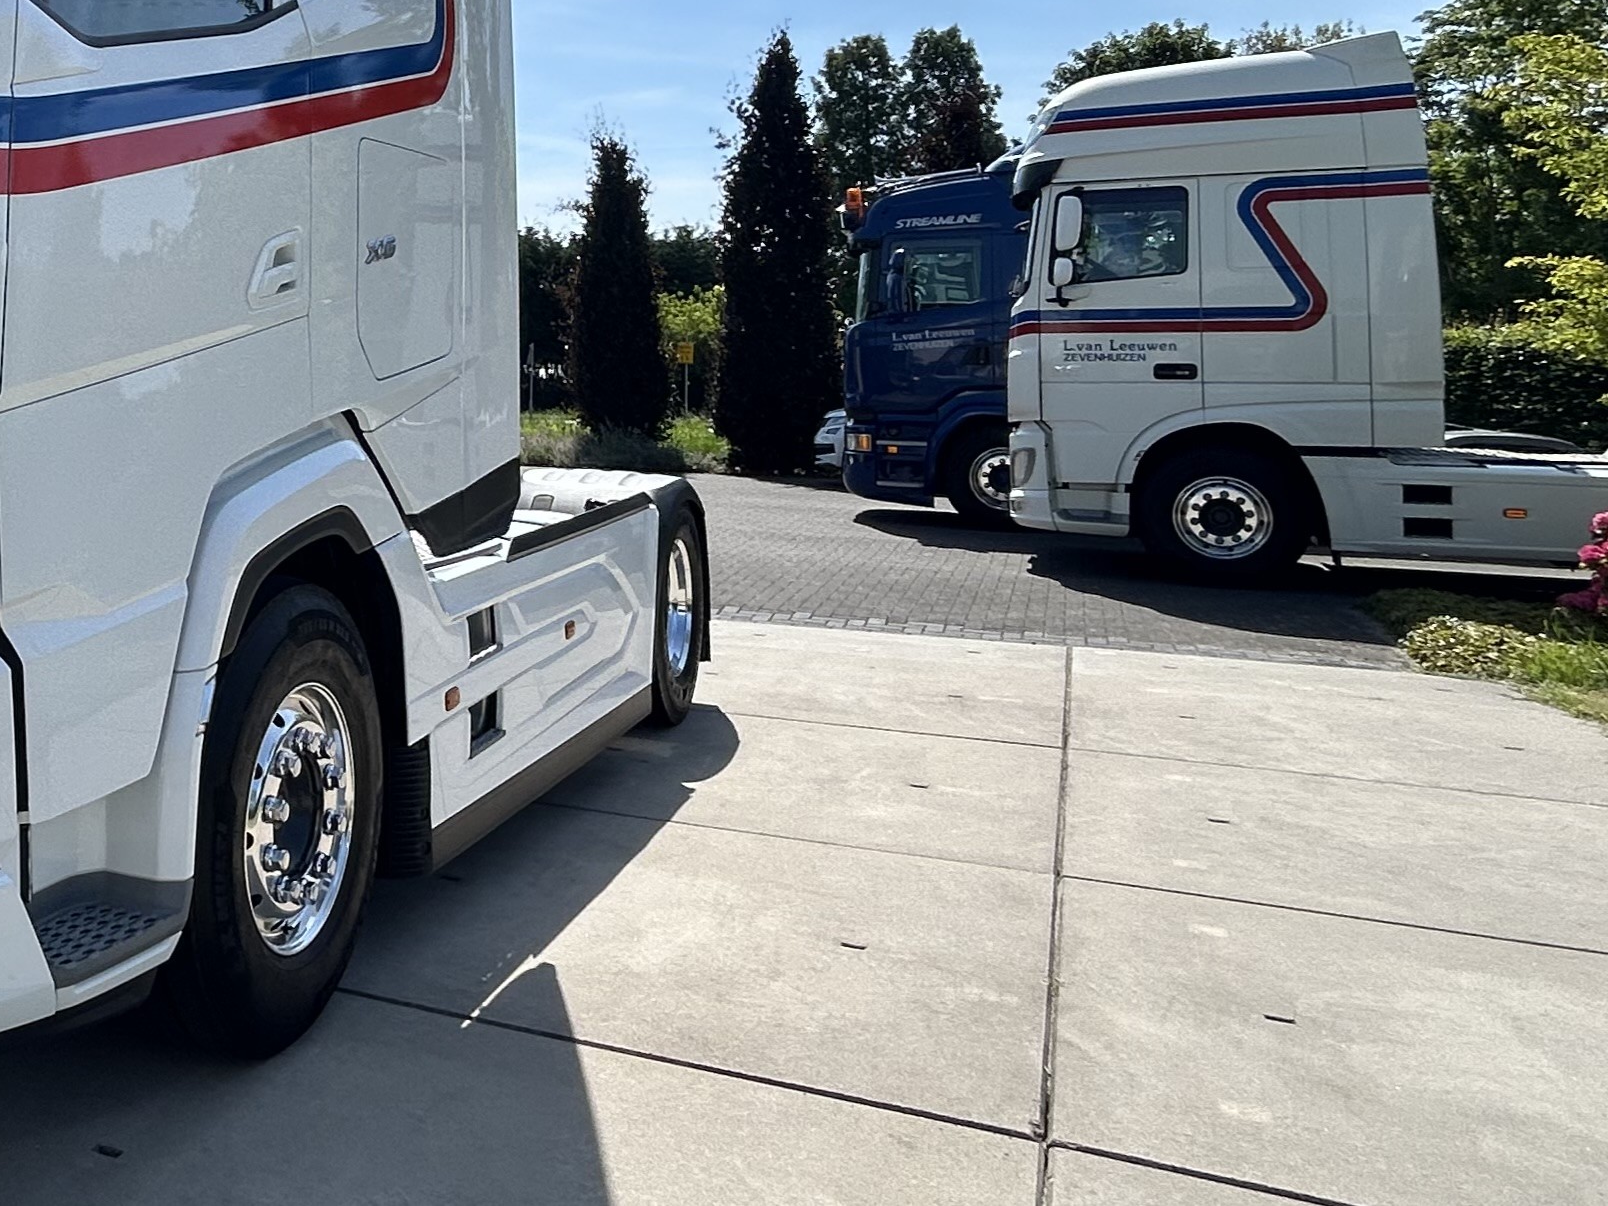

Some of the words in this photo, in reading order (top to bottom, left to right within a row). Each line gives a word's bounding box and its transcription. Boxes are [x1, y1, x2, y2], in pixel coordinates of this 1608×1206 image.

[894, 213, 983, 229] STREAMLINE
[1109, 339, 1178, 352] Leeuwen
[1063, 353, 1147, 362] ZEVENHUIZEN
